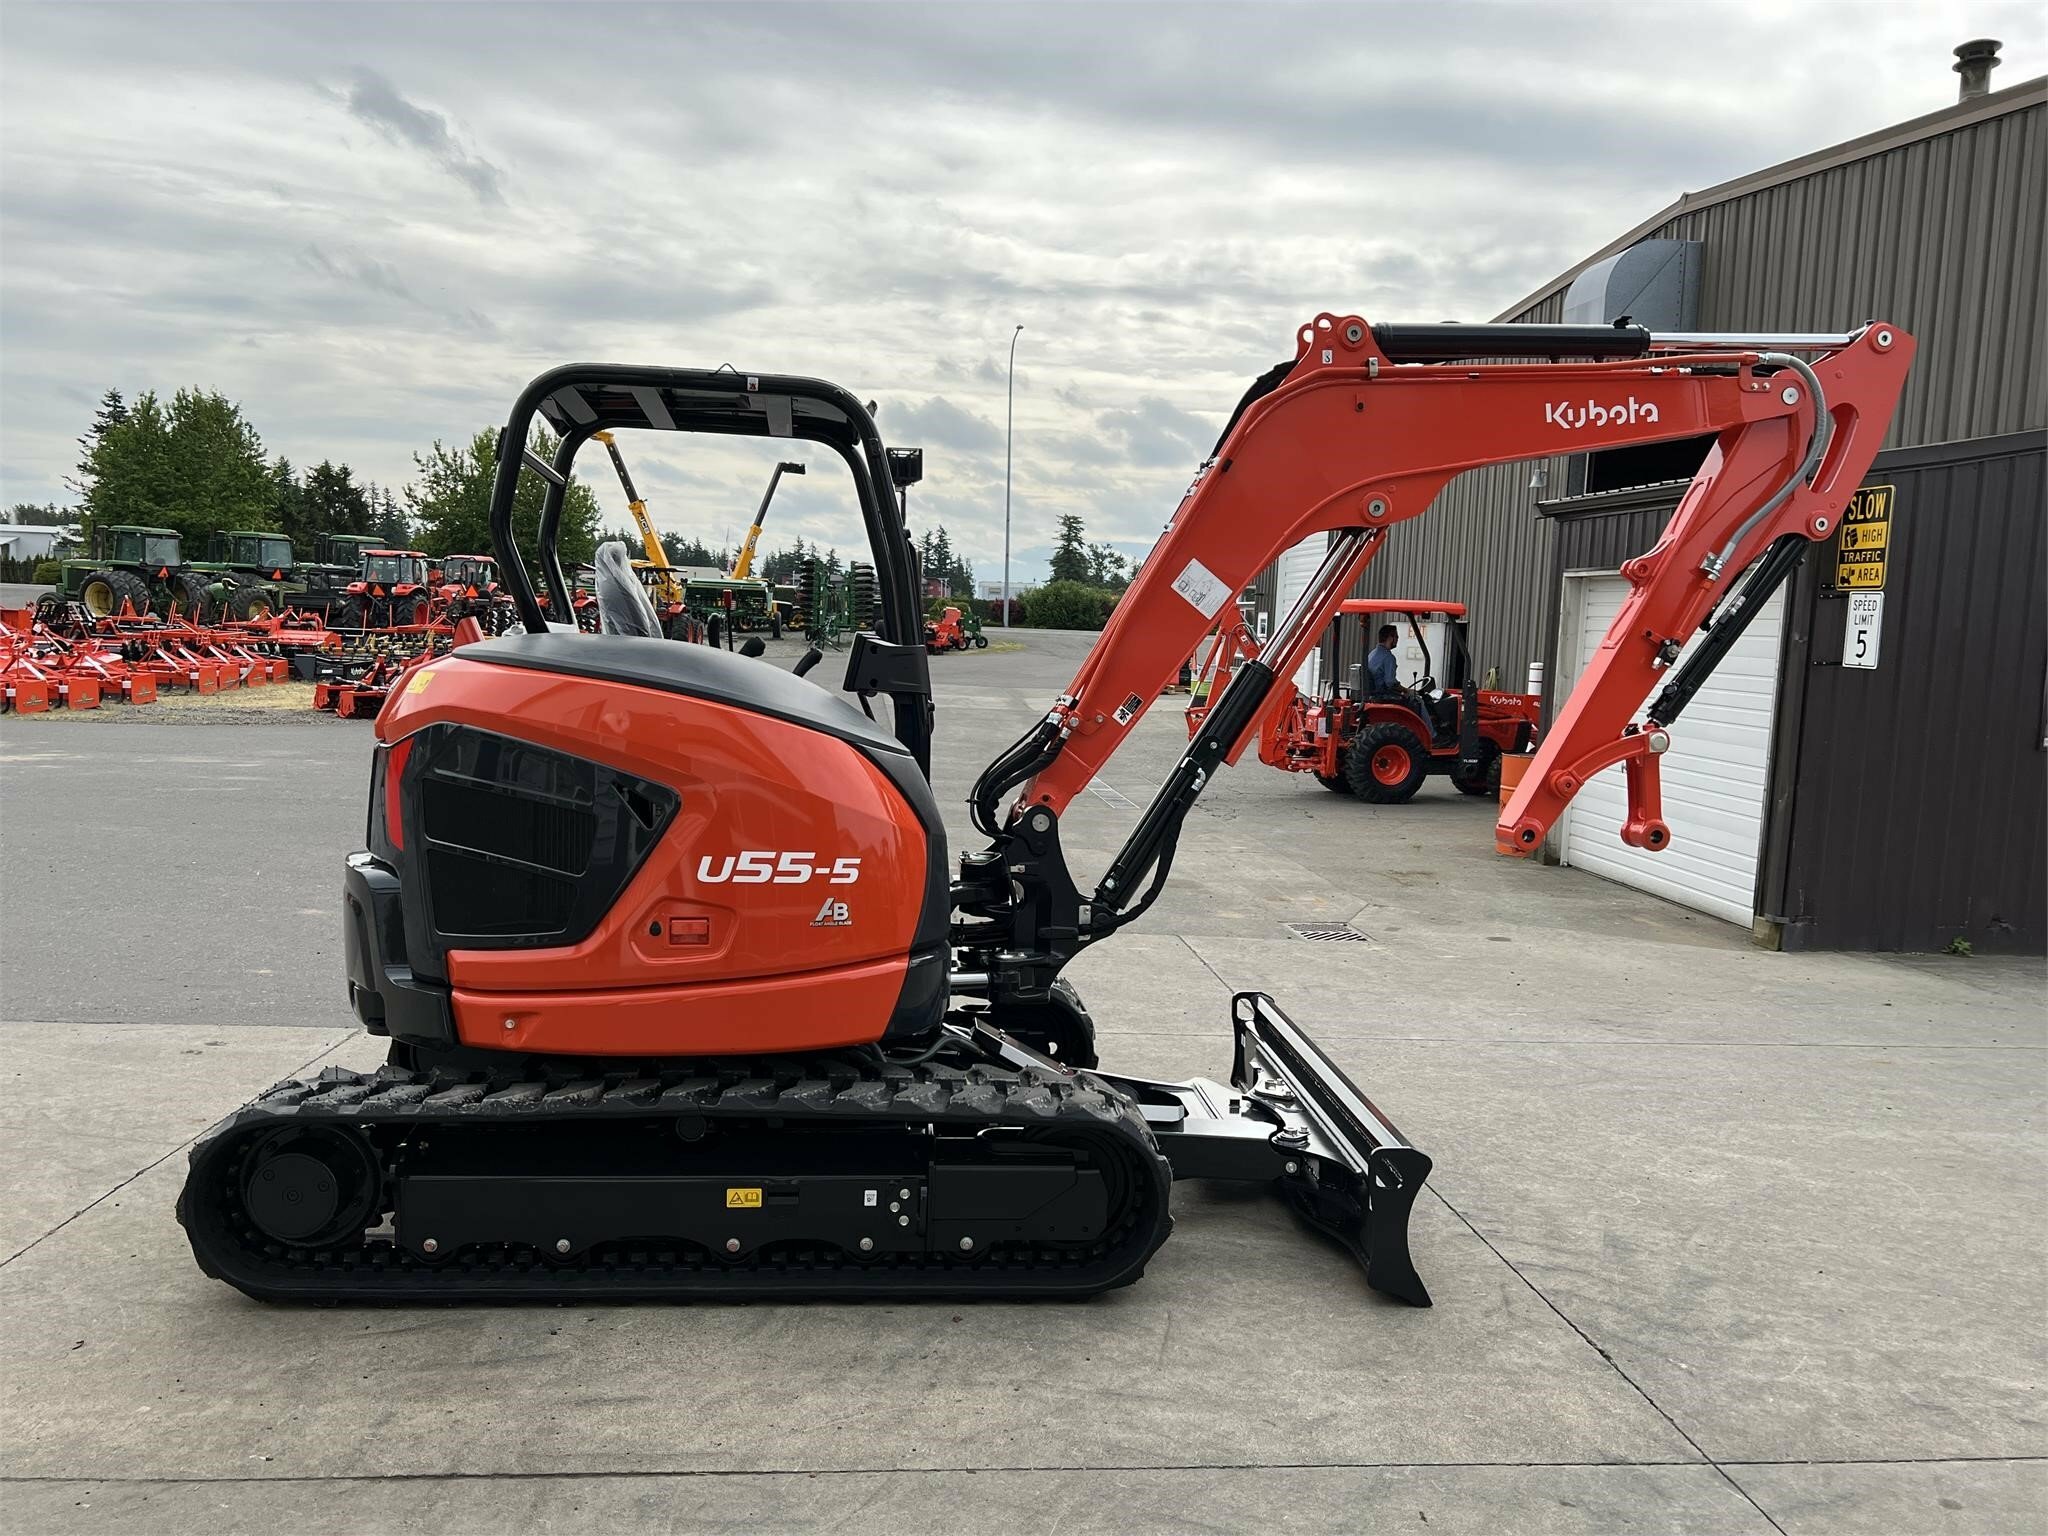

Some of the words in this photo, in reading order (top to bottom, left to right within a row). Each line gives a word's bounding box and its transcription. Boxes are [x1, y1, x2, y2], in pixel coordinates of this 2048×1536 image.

[1545, 396, 1659, 429] Kubota
[1848, 492, 1887, 520] SLOW
[639, 513, 650, 535] JCB
[1861, 528, 1883, 543] HIGH
[1843, 551, 1882, 563] TRAFFIC
[1857, 567, 1880, 581] AREA
[1853, 600, 1877, 611] SPEED
[1854, 614, 1874, 626] LIMIT
[1855, 630, 1867, 658] 5
[1489, 695, 1522, 706] Kubota
[697, 851, 861, 884] U55-5
